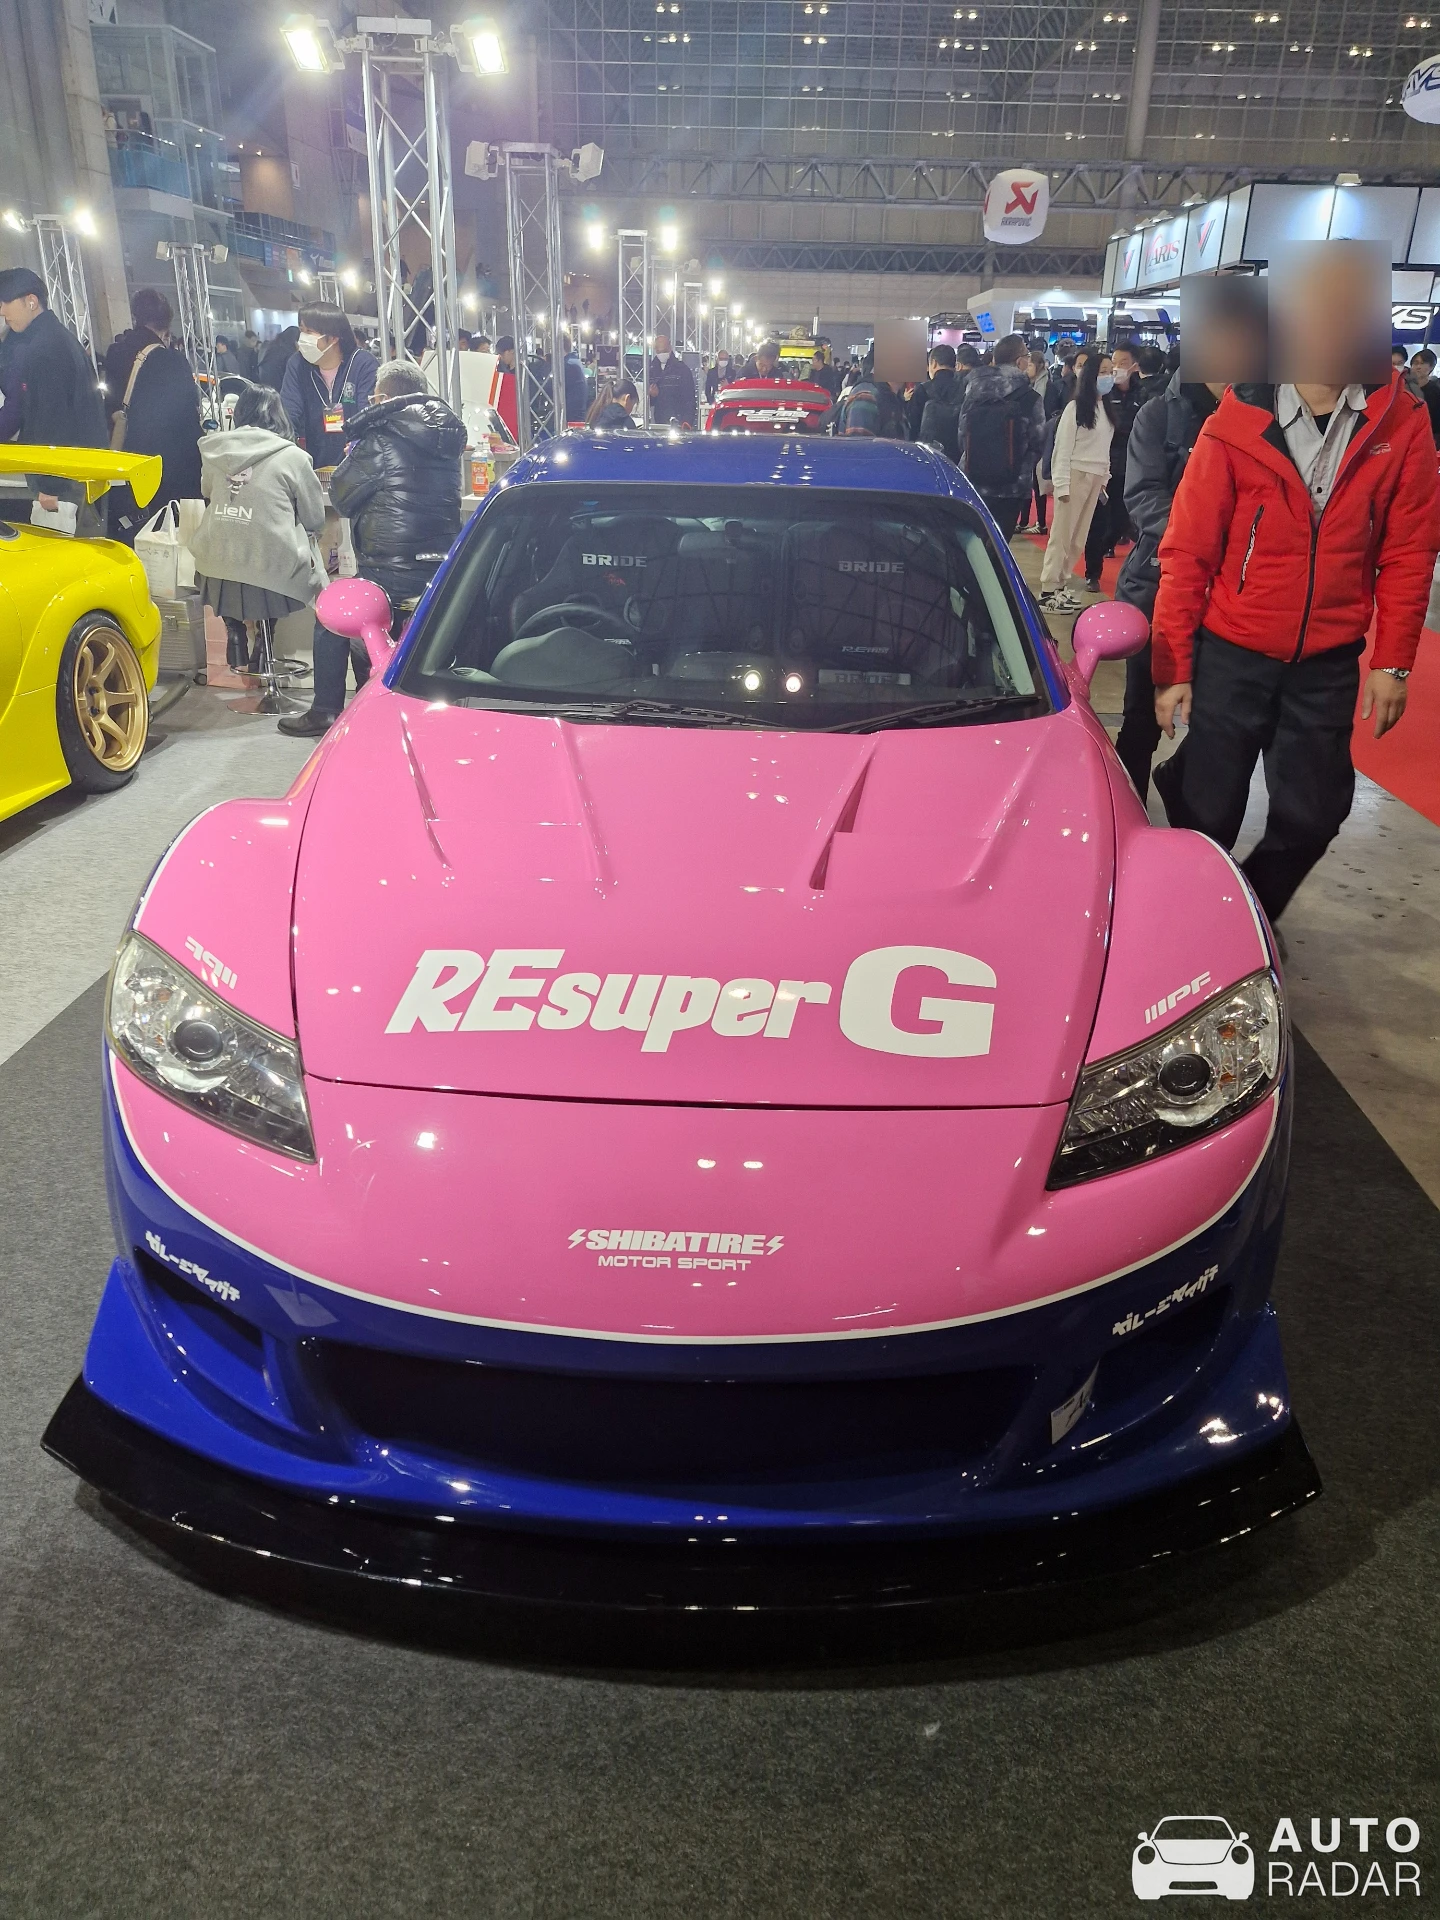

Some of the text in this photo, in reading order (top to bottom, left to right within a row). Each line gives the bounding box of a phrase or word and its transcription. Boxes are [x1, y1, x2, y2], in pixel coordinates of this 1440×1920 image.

[214, 503, 253, 520] LieN
[582, 553, 647, 567] BRIDE
[838, 560, 904, 573] BRIDE
[585, 1229, 767, 1256] SHIBATIRE
[597, 1255, 752, 1271] MOTOR SPORT
